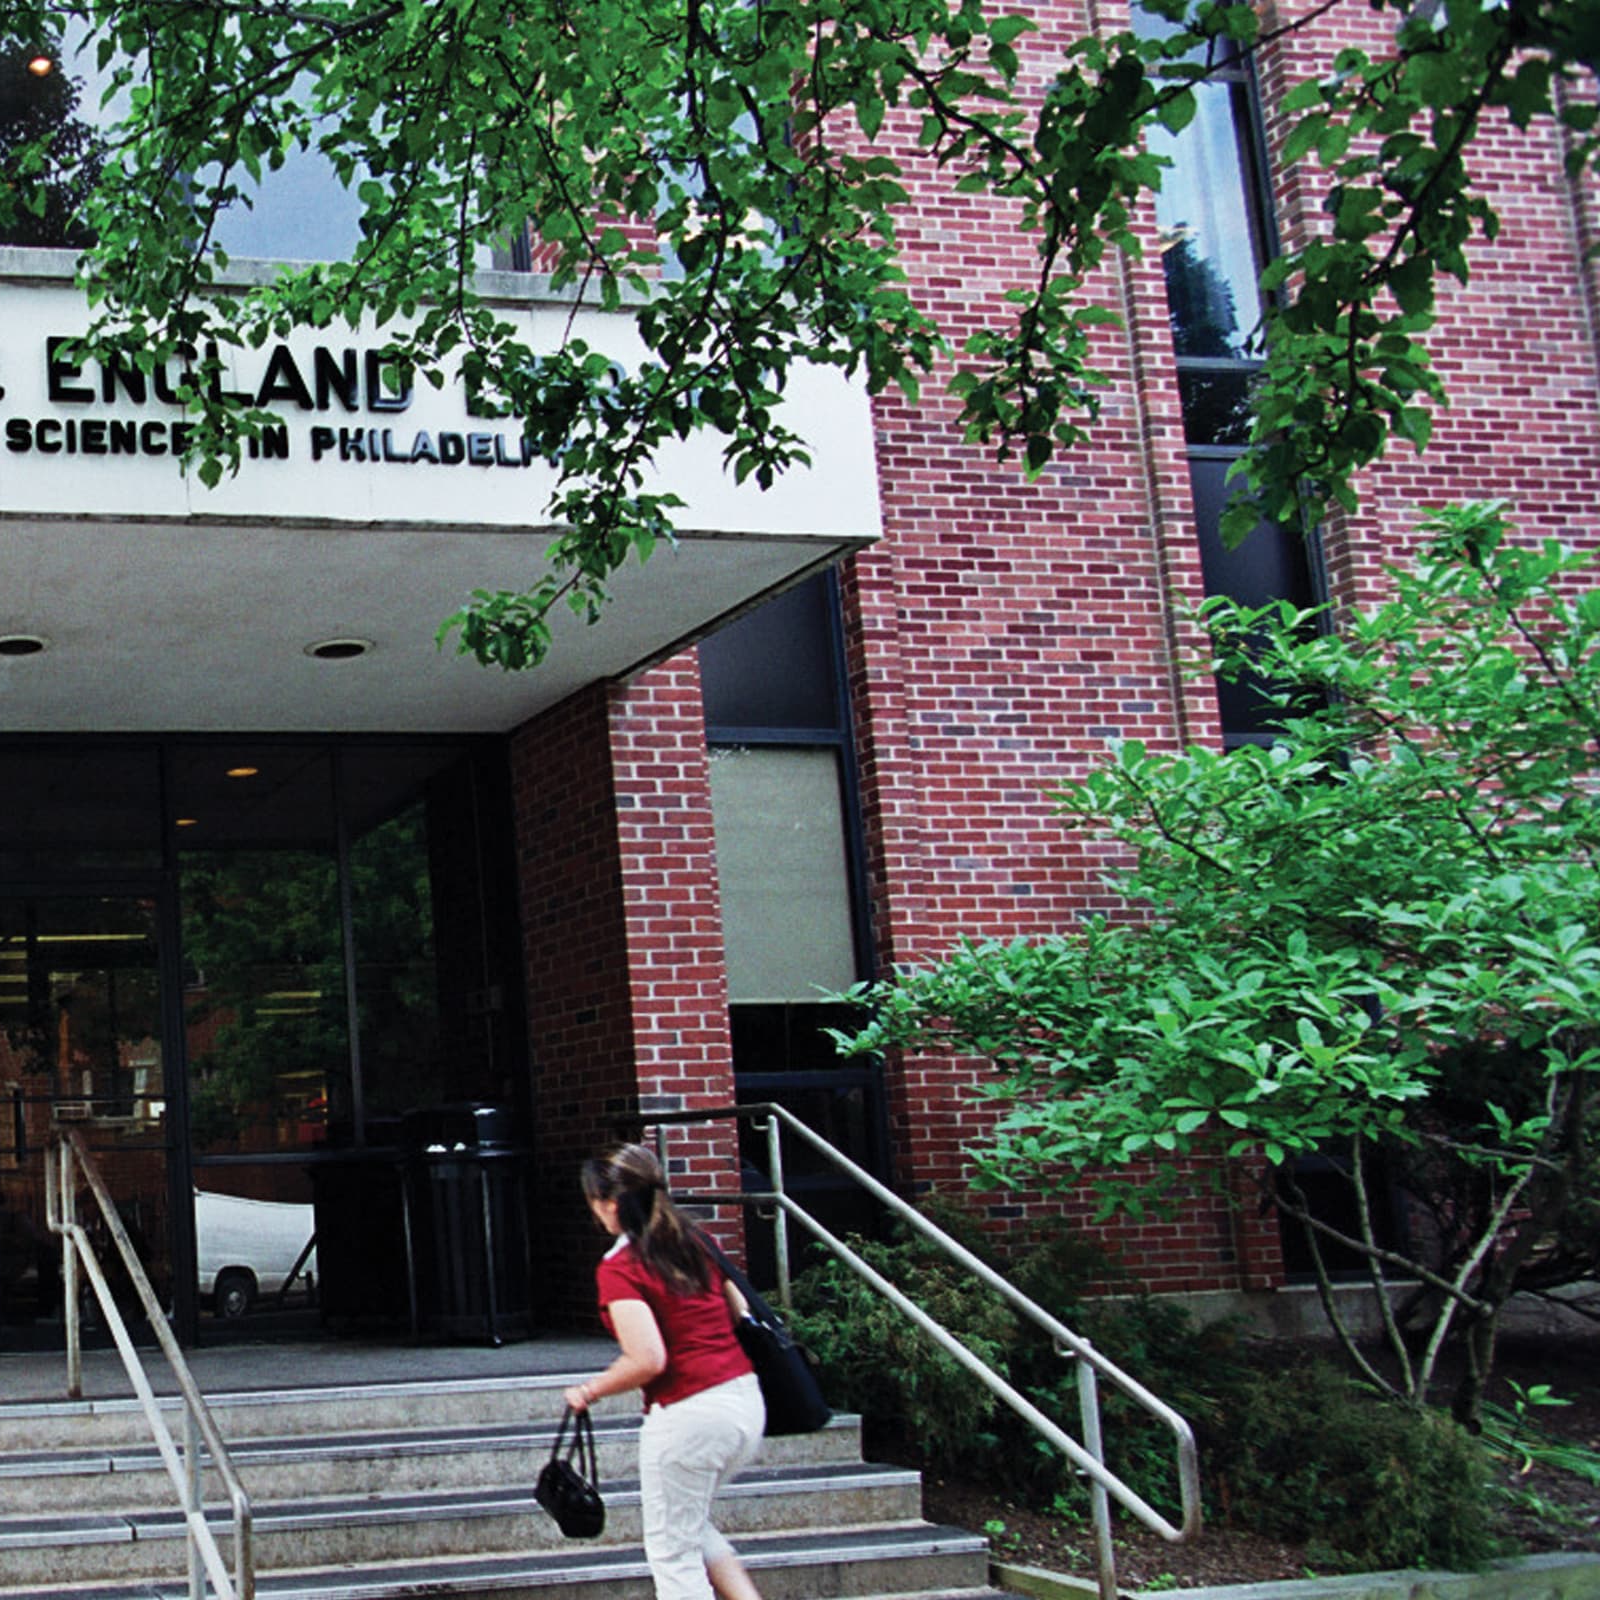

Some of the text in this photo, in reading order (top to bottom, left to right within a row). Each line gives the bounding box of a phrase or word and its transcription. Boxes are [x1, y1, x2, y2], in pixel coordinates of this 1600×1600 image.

[46, 336, 414, 414] ENGLAND
[5, 418, 224, 458] SCIENCE
[248, 424, 290, 460] IN
